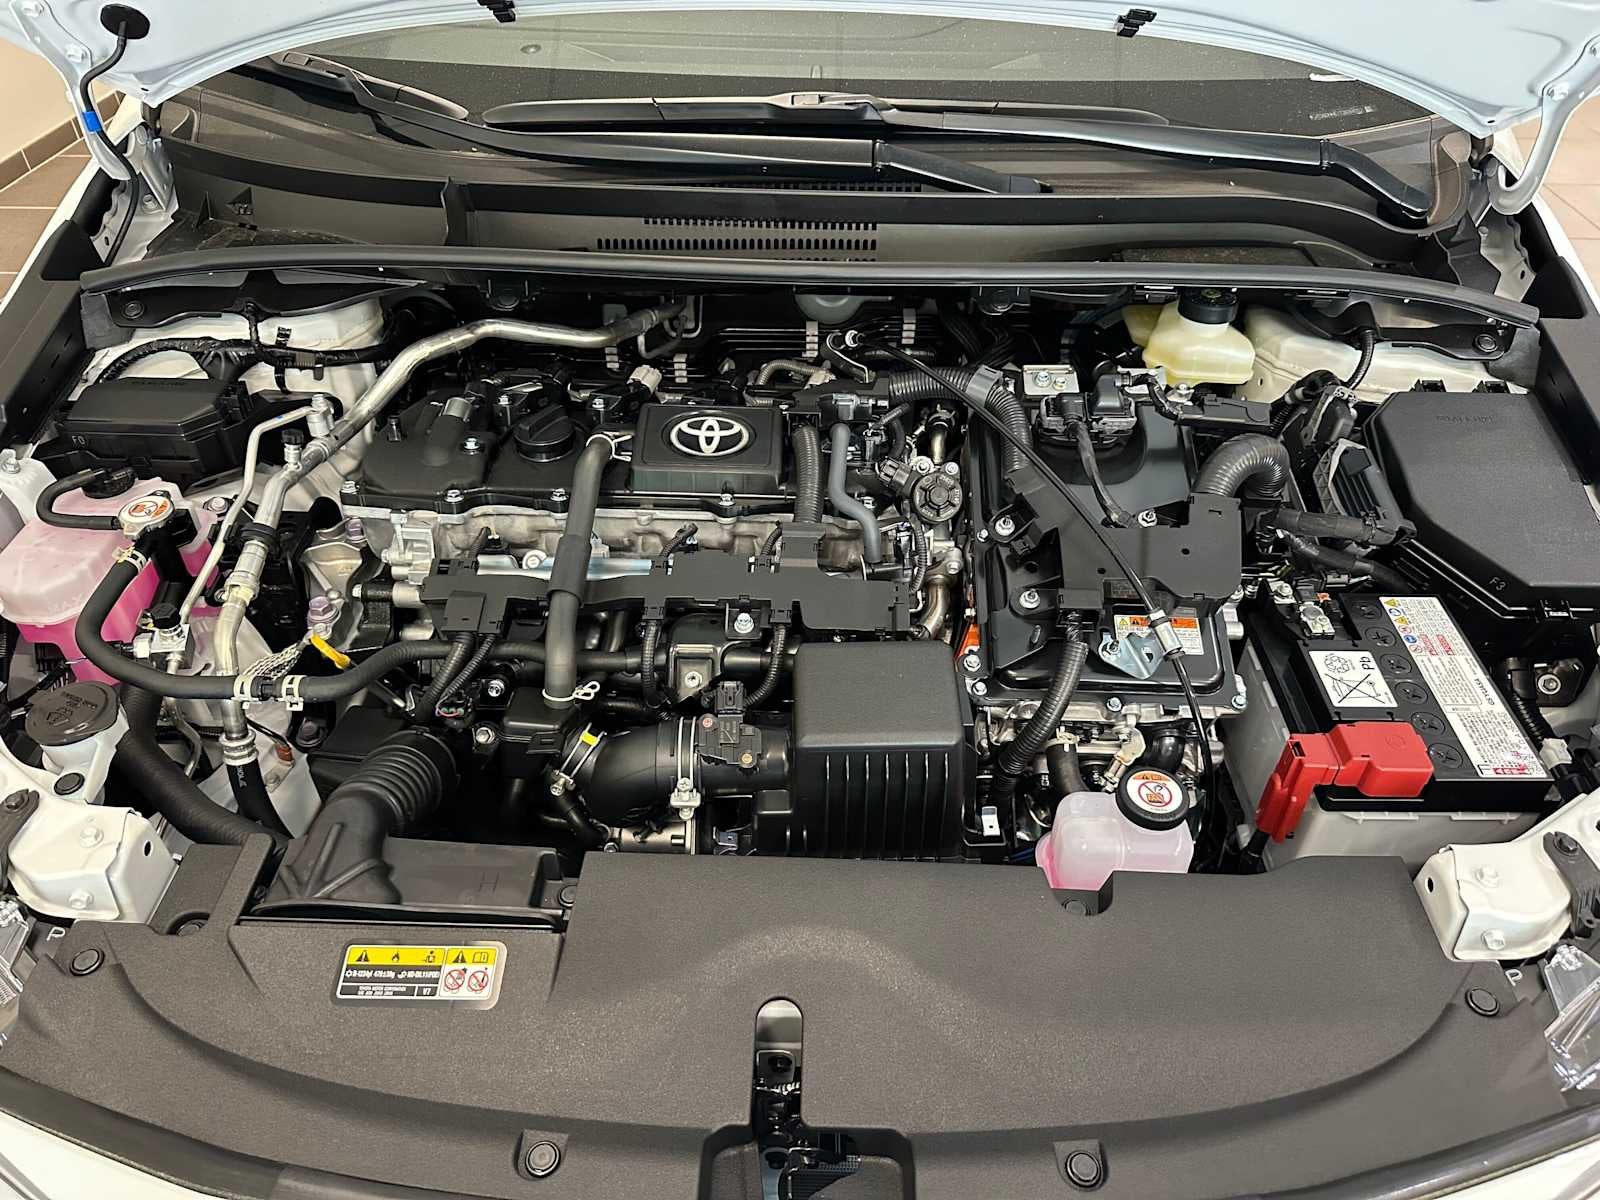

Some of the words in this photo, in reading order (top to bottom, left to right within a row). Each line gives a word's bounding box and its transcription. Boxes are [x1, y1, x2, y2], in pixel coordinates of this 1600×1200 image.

[1489, 576, 1506, 591] F3
[1359, 656, 1375, 670] Pb
[46, 926, 66, 941] P
[1504, 968, 1523, 987] P
